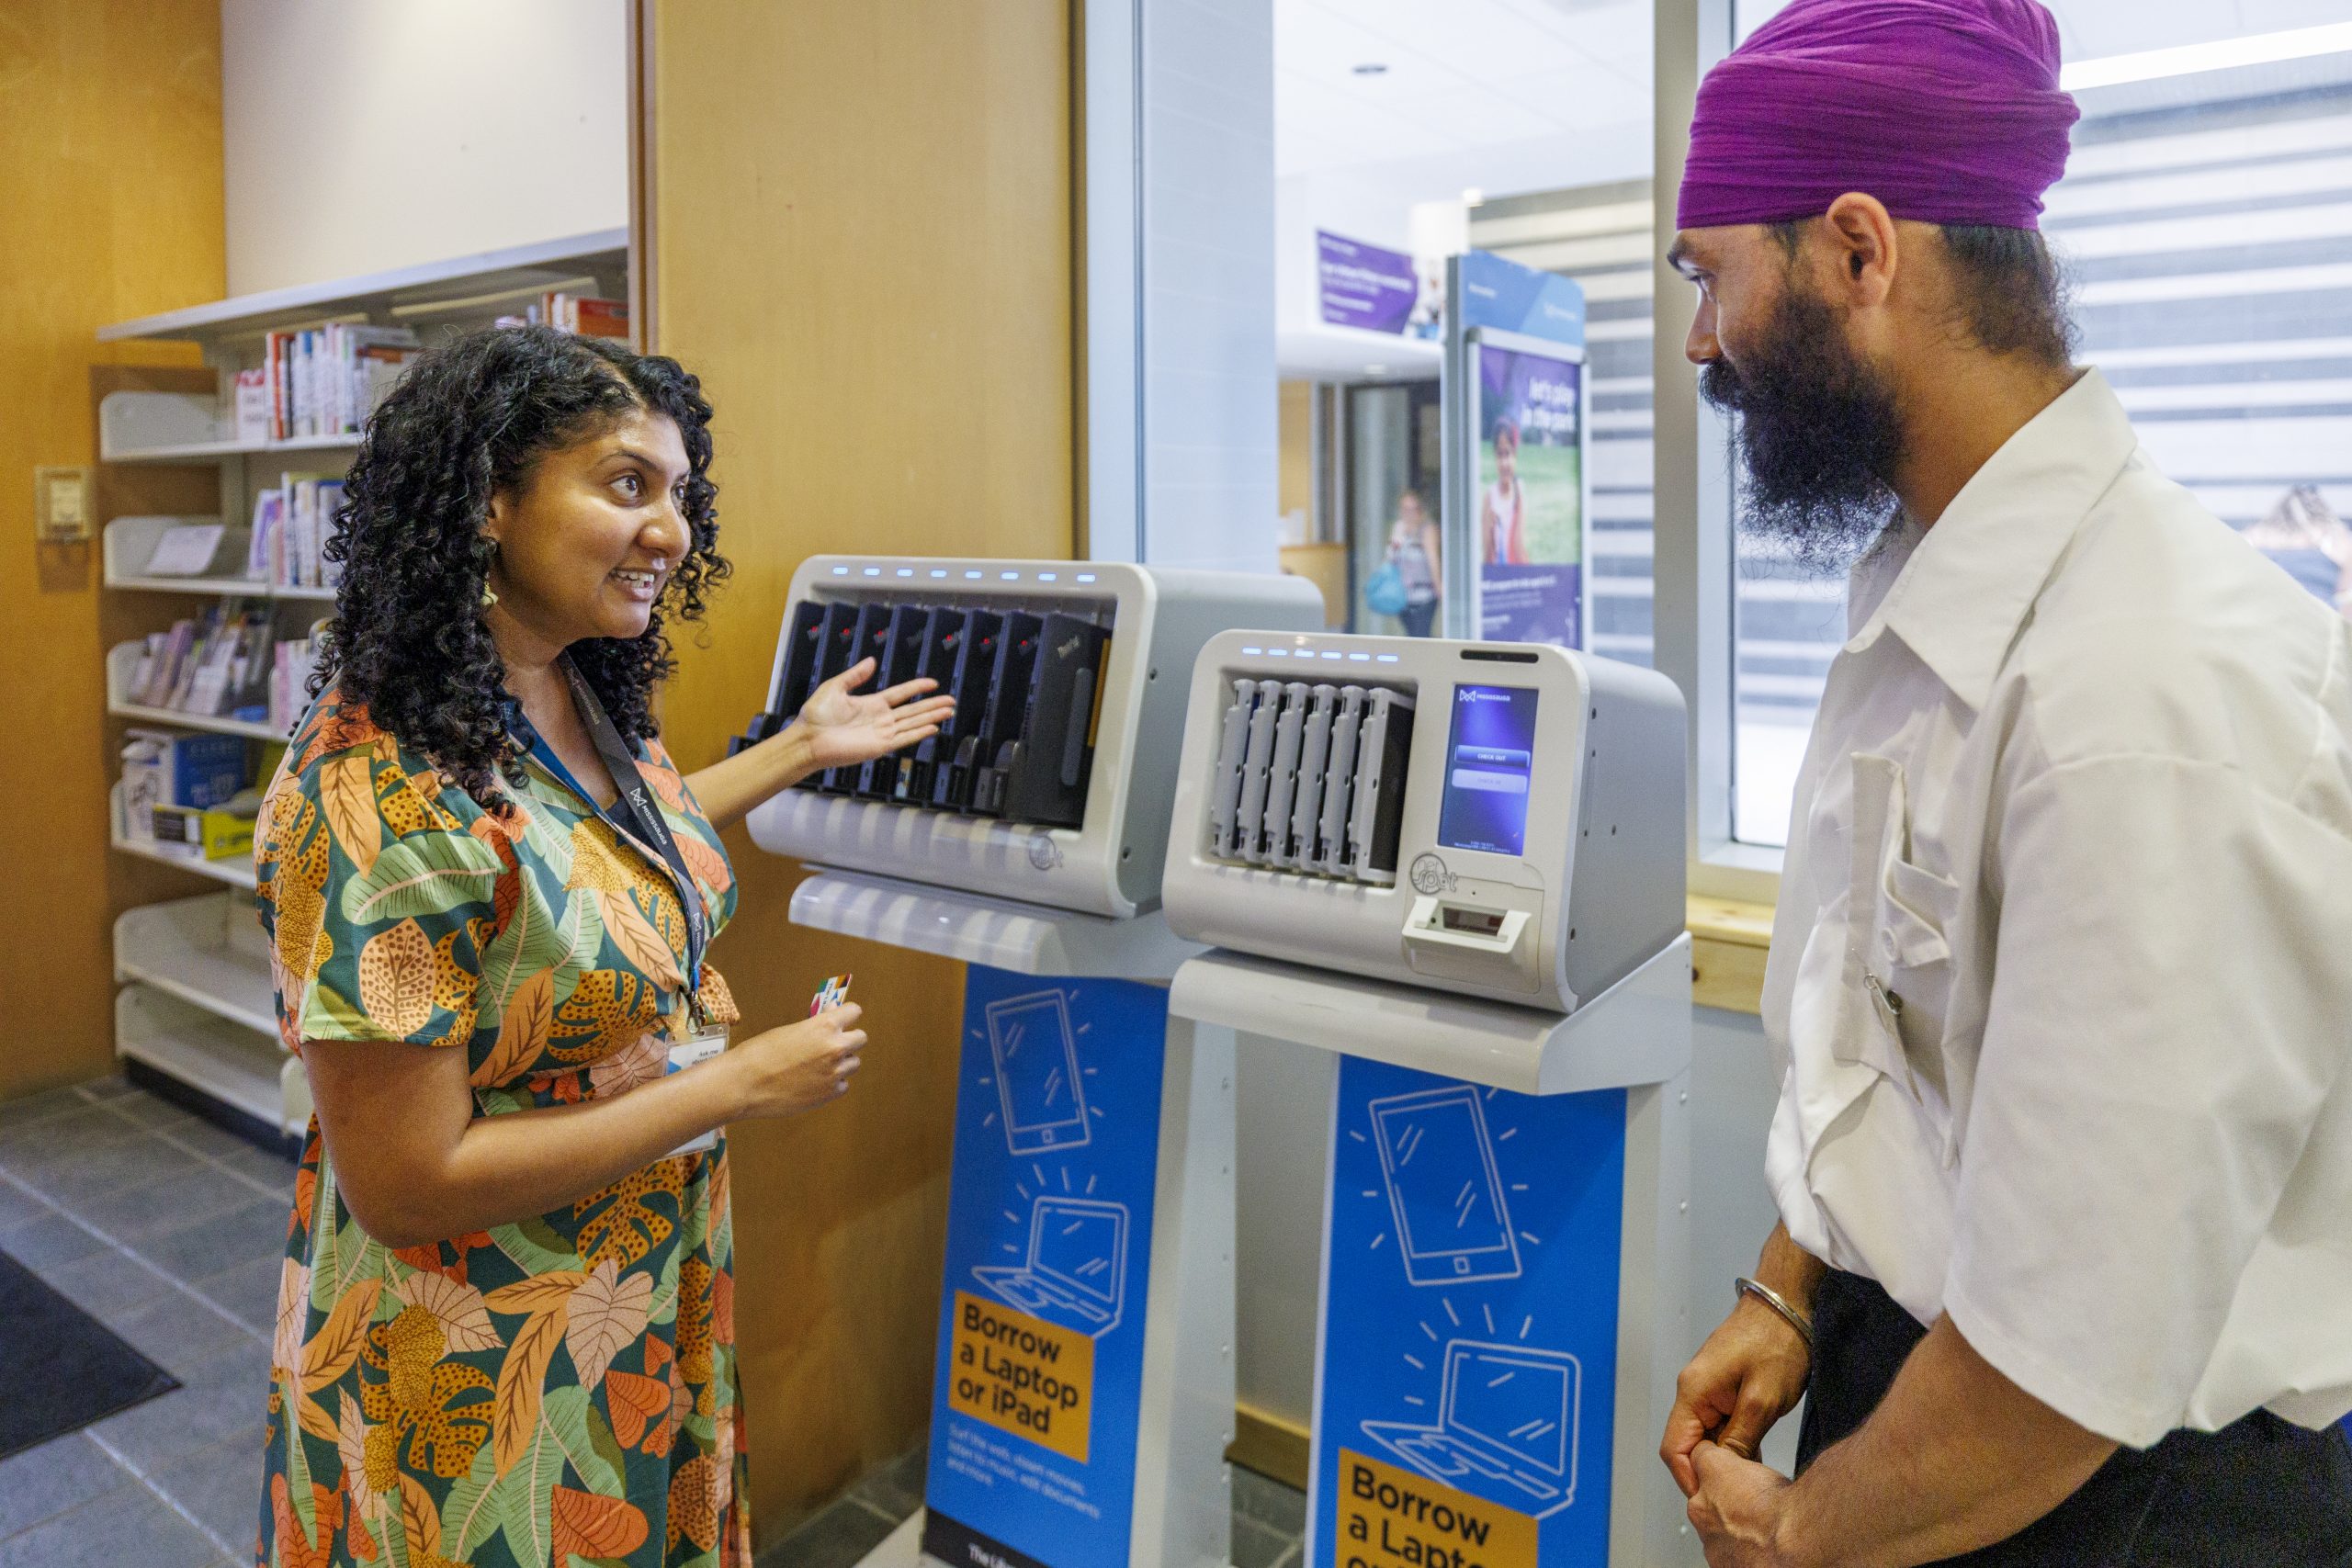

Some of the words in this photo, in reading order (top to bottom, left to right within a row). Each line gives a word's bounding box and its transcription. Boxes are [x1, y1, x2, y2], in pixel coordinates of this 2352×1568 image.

[965, 1303, 1060, 1363] Borrow
[958, 1378, 984, 1404] or
[992, 1384, 1051, 1434] iPad
[960, 1343, 974, 1366] a
[983, 1346, 1079, 1410] Laptop
[1352, 1464, 1489, 1546] Borrow
[1349, 1514, 1368, 1542] a
[1382, 1518, 1485, 1568] Lapt
